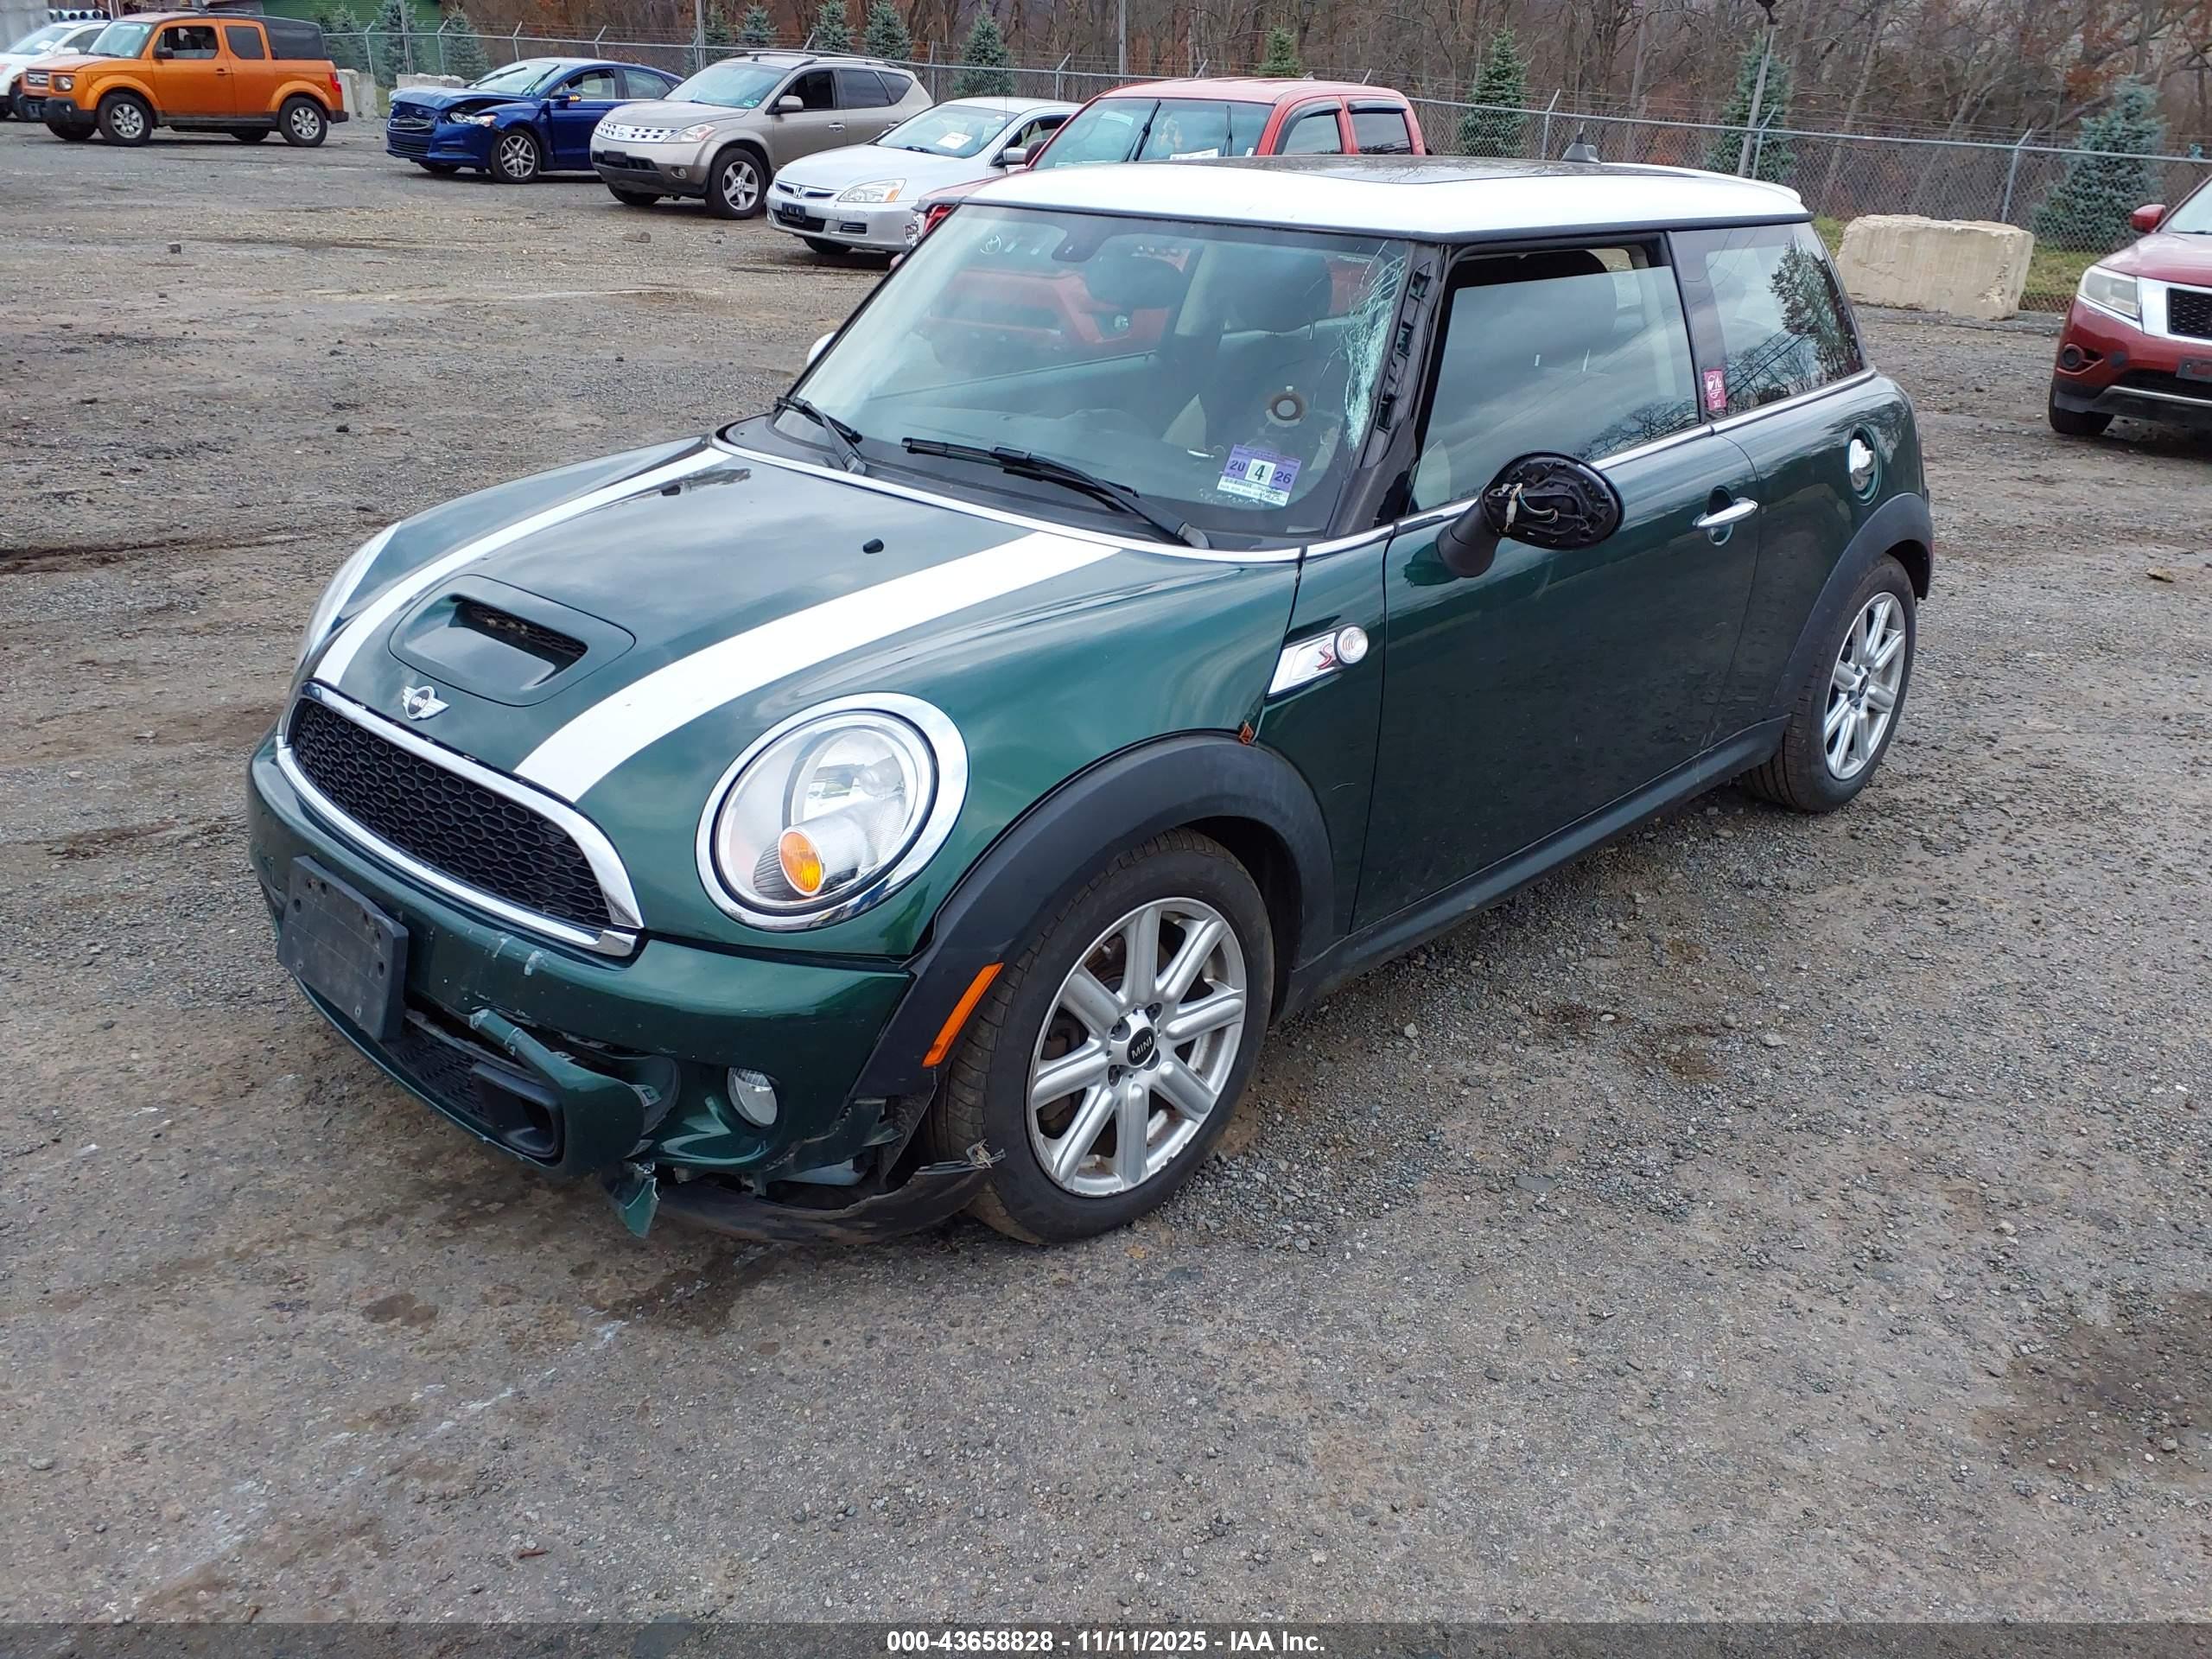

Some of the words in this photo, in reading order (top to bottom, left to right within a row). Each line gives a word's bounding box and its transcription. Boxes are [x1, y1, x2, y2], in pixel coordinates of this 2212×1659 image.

[1230, 460, 1246, 472] 20
[1255, 465, 1266, 481] 4
[1274, 471, 1293, 484] 26
[1131, 1036, 1153, 1059] MINI
